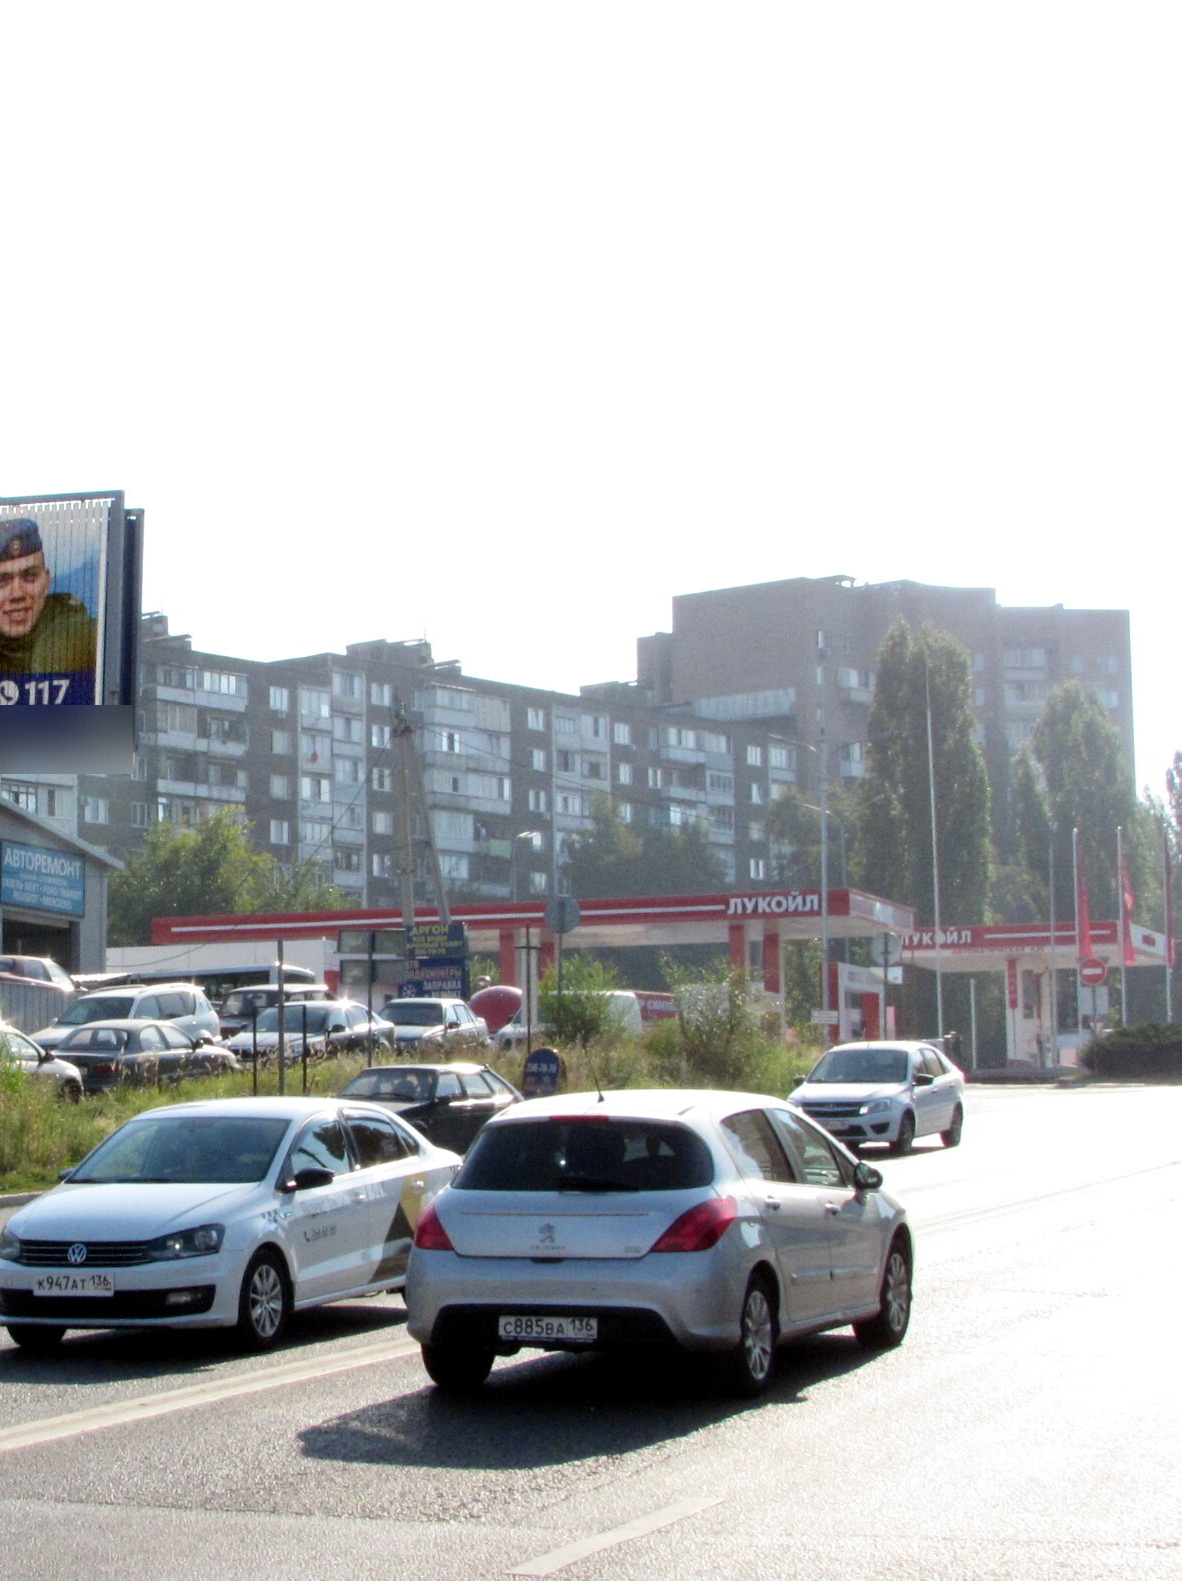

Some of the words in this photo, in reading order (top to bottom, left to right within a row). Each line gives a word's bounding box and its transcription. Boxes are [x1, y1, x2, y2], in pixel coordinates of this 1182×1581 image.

[24, 679, 69, 705] 117
[4, 847, 82, 880] АВТОРЕМОНТ
[727, 891, 819, 915] ЛУКОЙЛ
[412, 925, 449, 936] АРГОН
[91, 1275, 109, 1286] 136
[503, 1318, 565, 1336] С885ВА
[570, 1319, 593, 1331] 136
